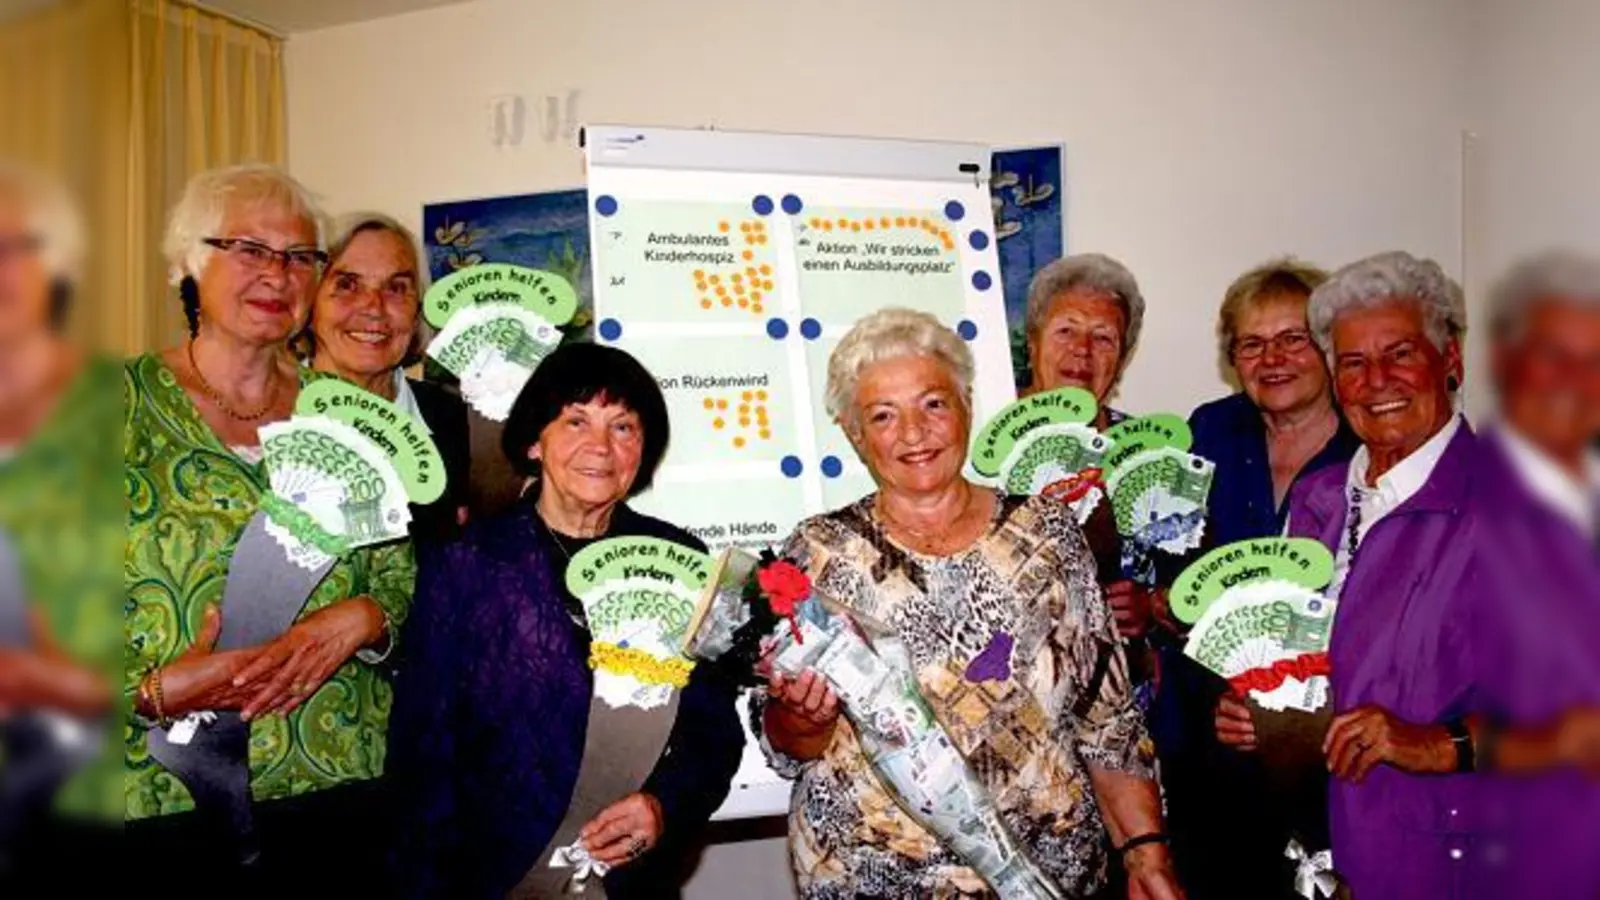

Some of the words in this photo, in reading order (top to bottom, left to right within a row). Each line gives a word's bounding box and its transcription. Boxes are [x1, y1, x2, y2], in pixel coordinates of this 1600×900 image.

[647, 232, 730, 247] Ambulantes
[816, 242, 858, 255] Aktion
[891, 244, 940, 257] stricken
[644, 250, 735, 265] Kinderhospiz
[803, 260, 840, 271] einen
[437, 270, 502, 312] Senioren
[509, 268, 558, 305] helfen
[682, 374, 769, 391] Rückenwind
[352, 416, 399, 458] Kindern
[983, 404, 1028, 460] Senioren
[1032, 394, 1081, 416] helfen
[1123, 419, 1173, 440] helfen
[314, 393, 398, 425] Senioren
[399, 421, 432, 485] helfen
[729, 521, 778, 536] Hände
[582, 544, 660, 582] Senioren
[1184, 547, 1245, 607] Senioren
[1251, 541, 1311, 571] helfen
[1219, 566, 1272, 589] Kindern
